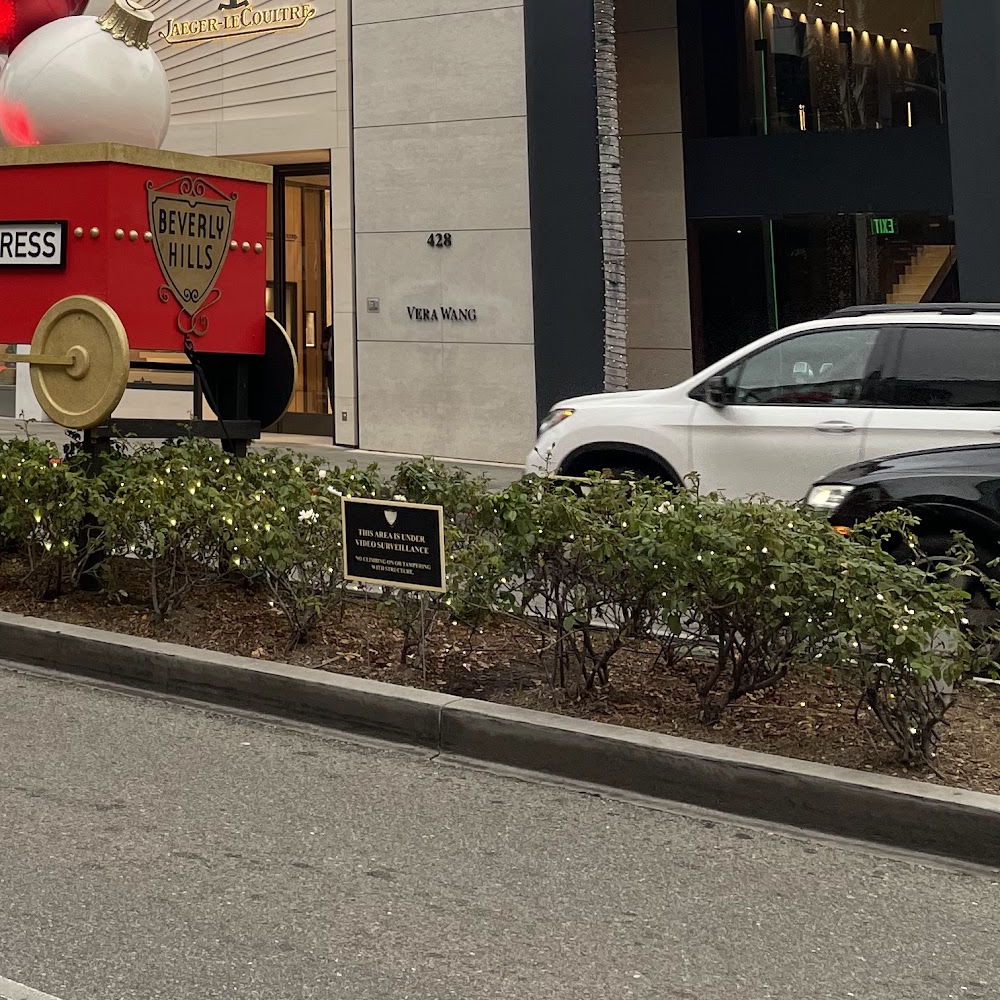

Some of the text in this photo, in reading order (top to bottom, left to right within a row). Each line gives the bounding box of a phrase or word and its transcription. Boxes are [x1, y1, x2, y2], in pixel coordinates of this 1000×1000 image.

[159, 208, 224, 240] BEVERLY
[426, 232, 452, 248] 428
[169, 242, 213, 270] HILLS
[406, 306, 477, 321] VERA WANG
[357, 528, 426, 544] THIS AREA IS UNDER
[355, 538, 430, 555] VIDEO SURVEILLANCE
